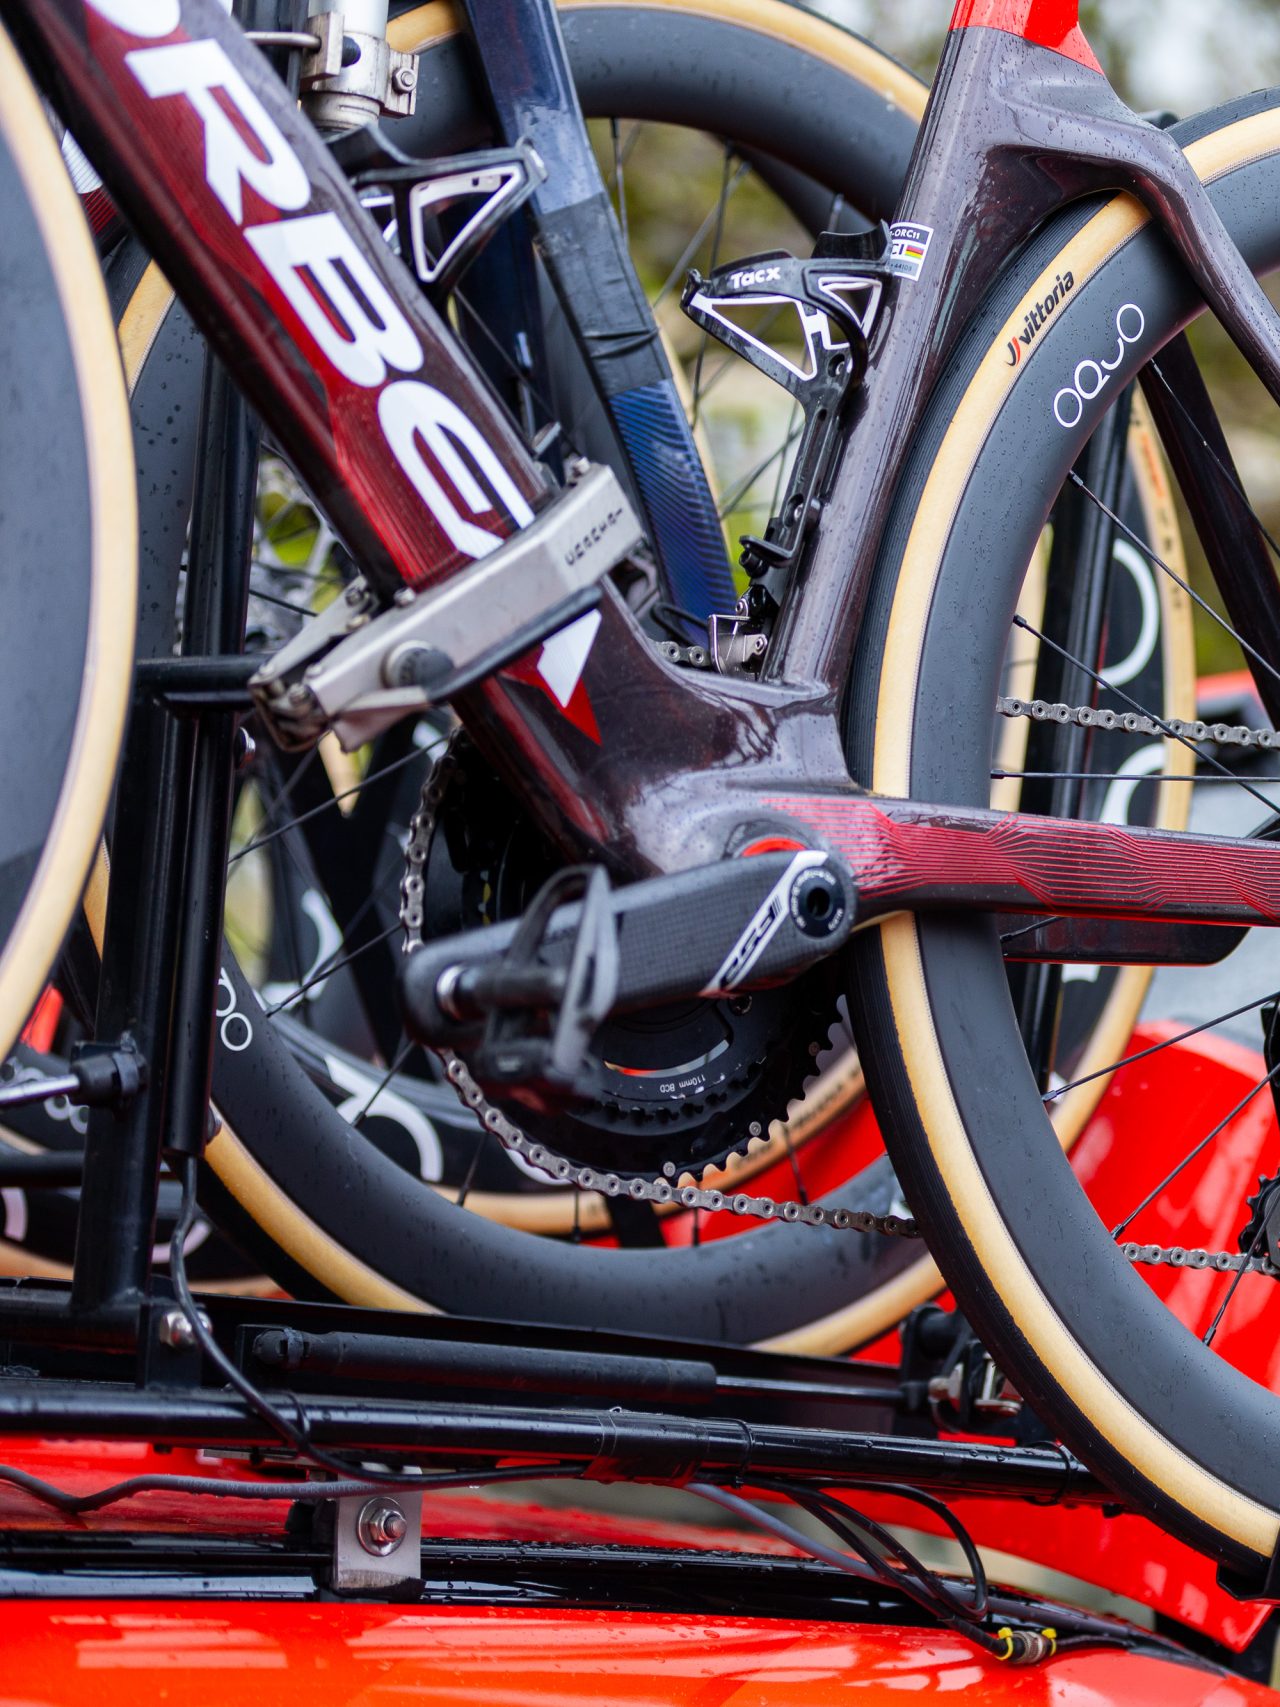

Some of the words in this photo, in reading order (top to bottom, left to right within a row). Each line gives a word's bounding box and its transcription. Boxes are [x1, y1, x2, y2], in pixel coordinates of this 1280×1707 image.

[730, 266, 781, 289] Tacx
[1018, 270, 1075, 345] vittoria
[1053, 303, 1145, 428] OQUO
[659, 1083, 676, 1094] BCD
[678, 1073, 706, 1089] 110mm
